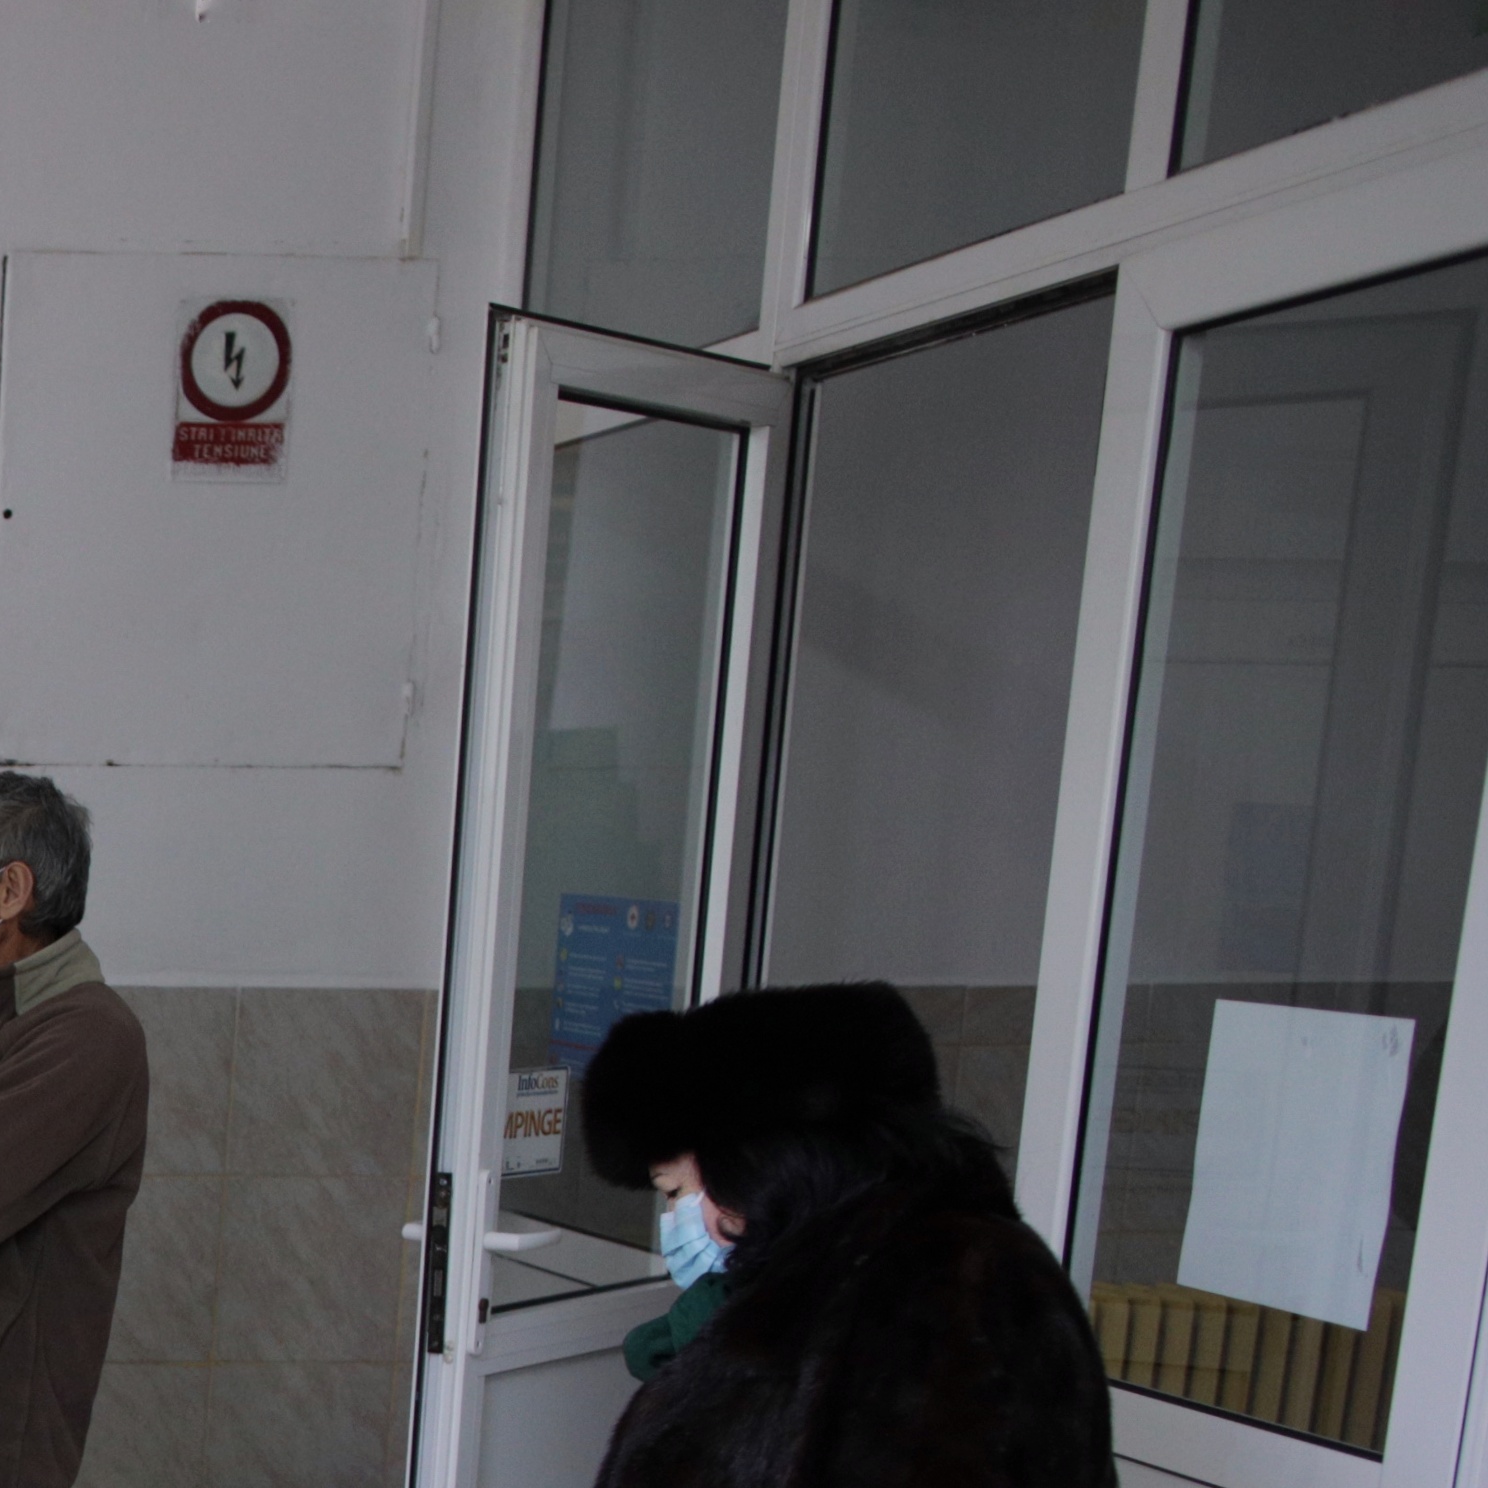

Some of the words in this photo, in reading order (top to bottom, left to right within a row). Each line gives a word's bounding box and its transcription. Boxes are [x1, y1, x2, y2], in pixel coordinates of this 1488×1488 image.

[193, 444, 267, 458] TENSIUNE
[517, 1072, 560, 1090] InfoCons
[503, 1107, 563, 1140] MPINGE
